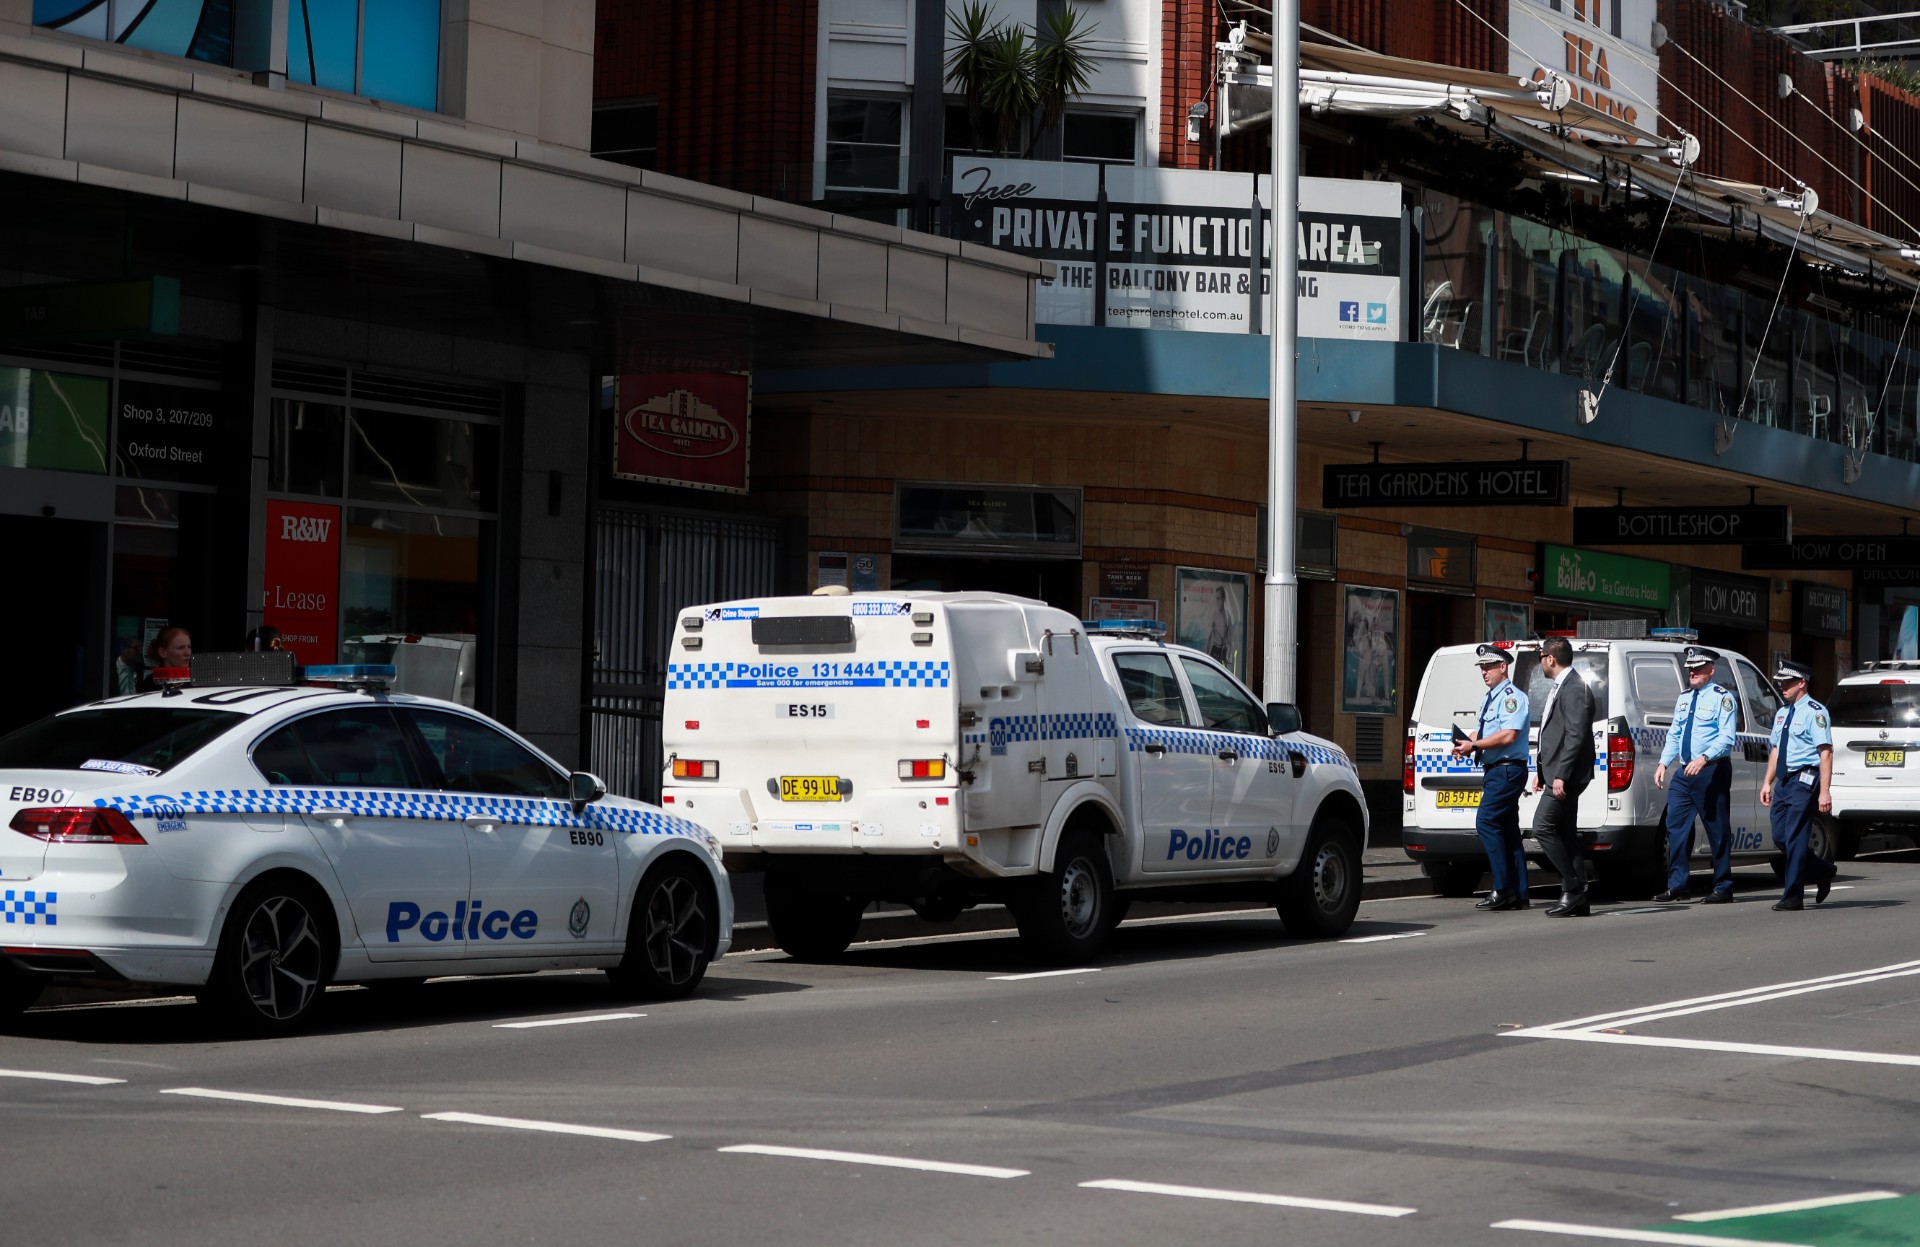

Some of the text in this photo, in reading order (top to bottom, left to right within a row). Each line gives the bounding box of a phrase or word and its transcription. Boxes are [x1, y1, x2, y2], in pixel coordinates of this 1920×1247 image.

[1562, 31, 1611, 90] TEA
[961, 166, 1036, 210] Free
[1061, 266, 1093, 288] THE
[1109, 268, 1190, 292] BALCONY
[1195, 271, 1231, 294] BAR
[1108, 306, 1243, 321] teagardenshotel.com.au
[0, 404, 30, 433] AB
[123, 403, 213, 428] Shop 3, 207/209
[640, 413, 665, 432] TEA
[128, 442, 204, 464] Oxford Street
[1336, 470, 1548, 498] TEA GARDENS HOTEL
[281, 515, 332, 543] R&W
[1618, 514, 1741, 536] BOTTLESHOP
[1792, 543, 1886, 561] NOW OPEN
[275, 585, 326, 611] Lease
[1601, 578, 1659, 601] Tea Gardens Hotel
[868, 603, 880, 615] 333
[1704, 586, 1757, 617] NOW OPEN
[737, 663, 875, 678] Police 131 444
[789, 704, 827, 717] ES15
[990, 730, 1006, 746] 000
[1866, 752, 1902, 762] CN 92 TE
[1268, 762, 1285, 774] ES15
[9, 786, 65, 804] EB90
[782, 779, 799, 795] DE
[803, 780, 818, 795] 99
[1437, 792, 1479, 803] DB 59 FE
[154, 803, 185, 821] 000
[157, 821, 187, 833] EMERGENCY
[570, 831, 604, 846] EB90
[1167, 829, 1251, 860] Police
[1731, 827, 1762, 849] lice
[386, 900, 538, 943] Police
